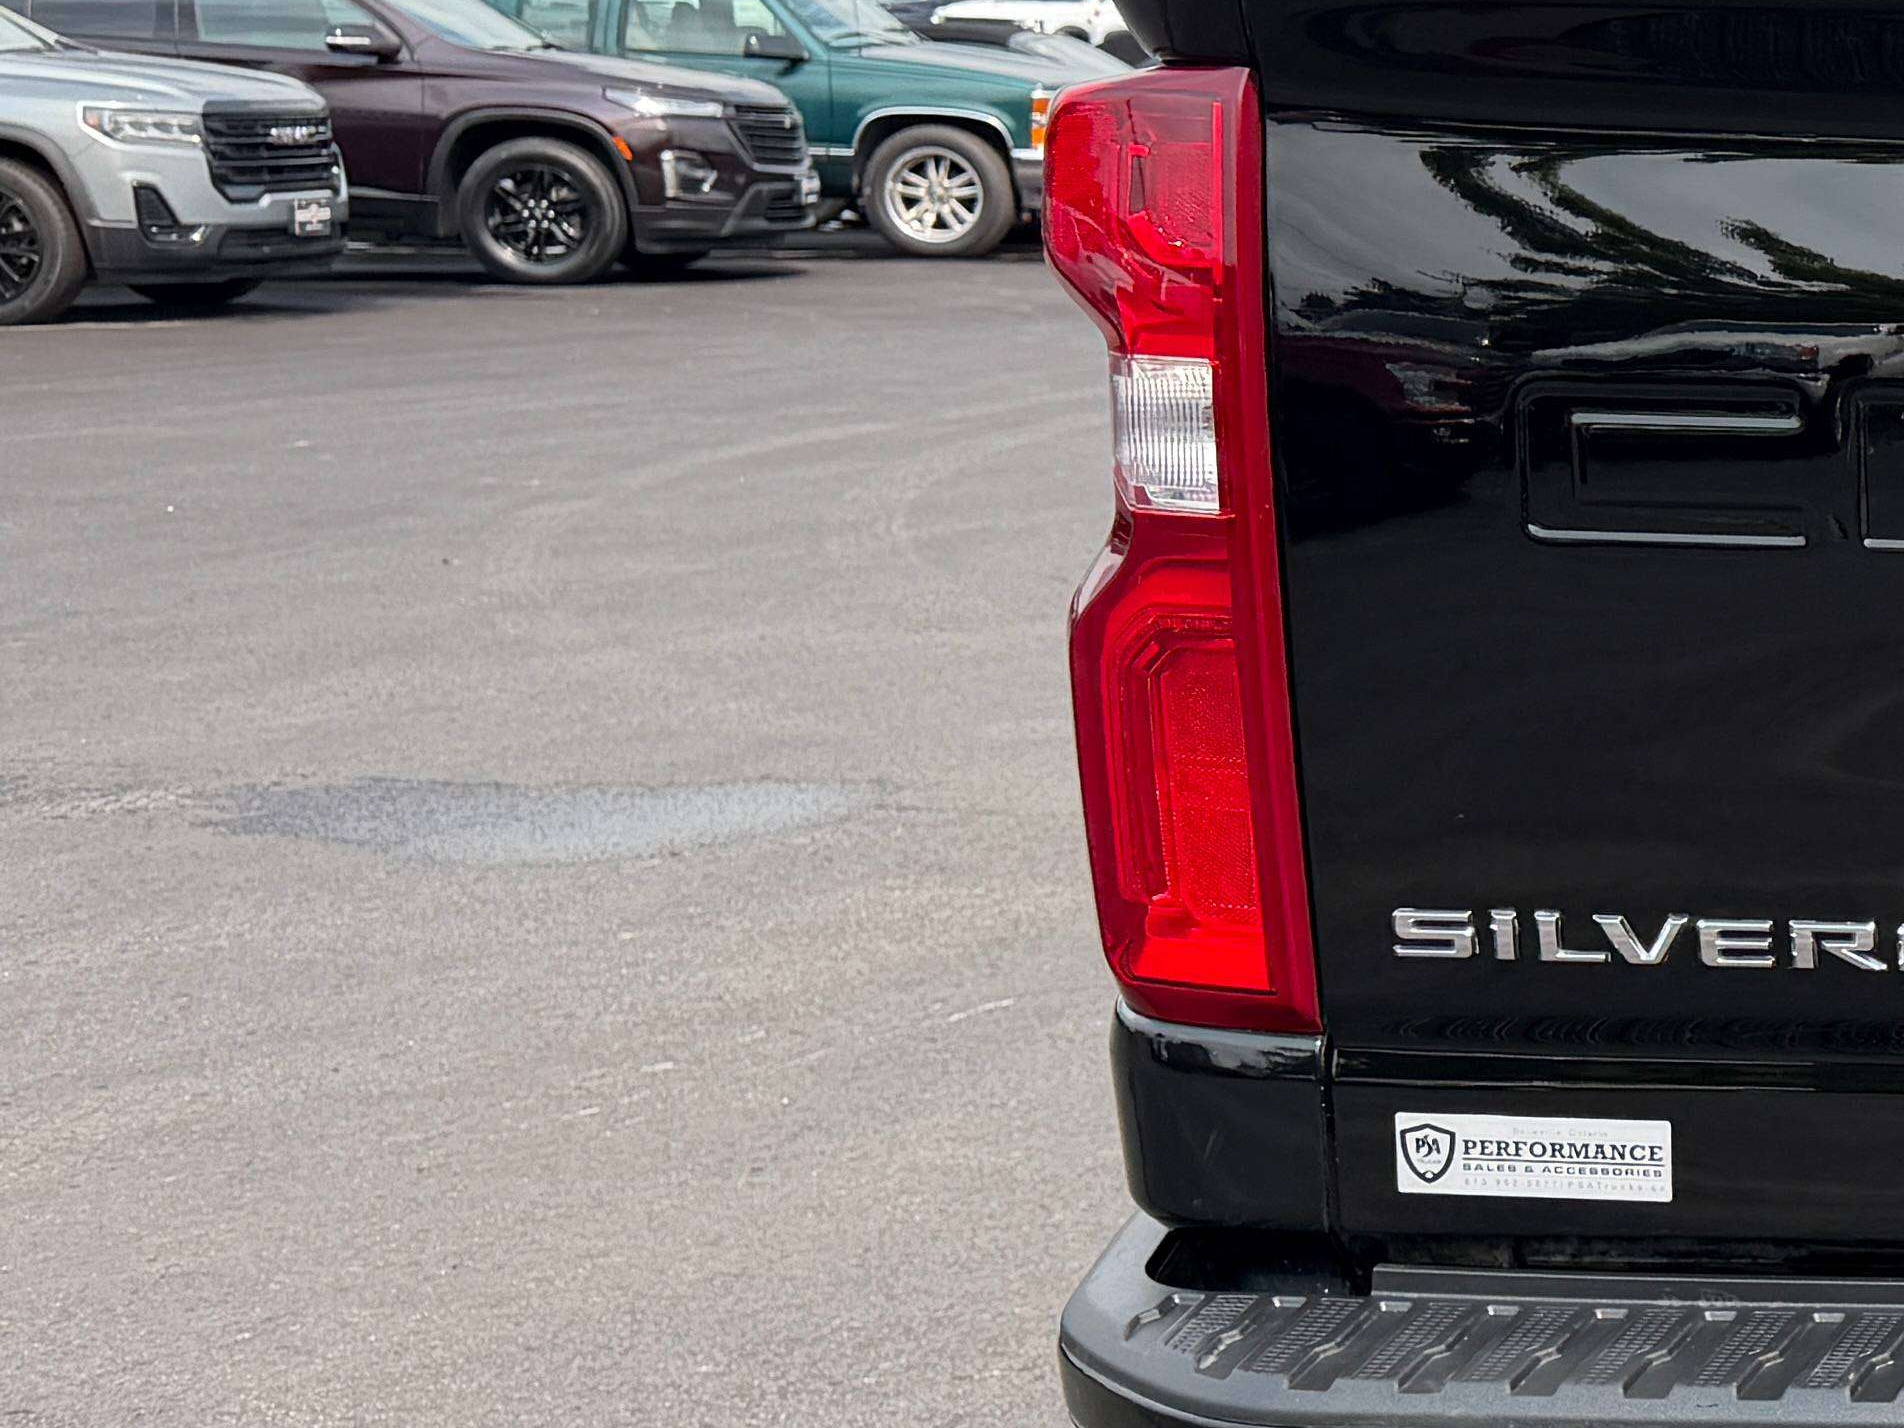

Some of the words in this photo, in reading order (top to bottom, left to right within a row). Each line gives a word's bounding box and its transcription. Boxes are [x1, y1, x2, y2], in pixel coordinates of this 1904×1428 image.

[1462, 1138, 1665, 1163] PERFORMANCE
[1462, 1162, 1518, 1174] SALES
[1542, 1165, 1664, 1178] ACCESSORIES
